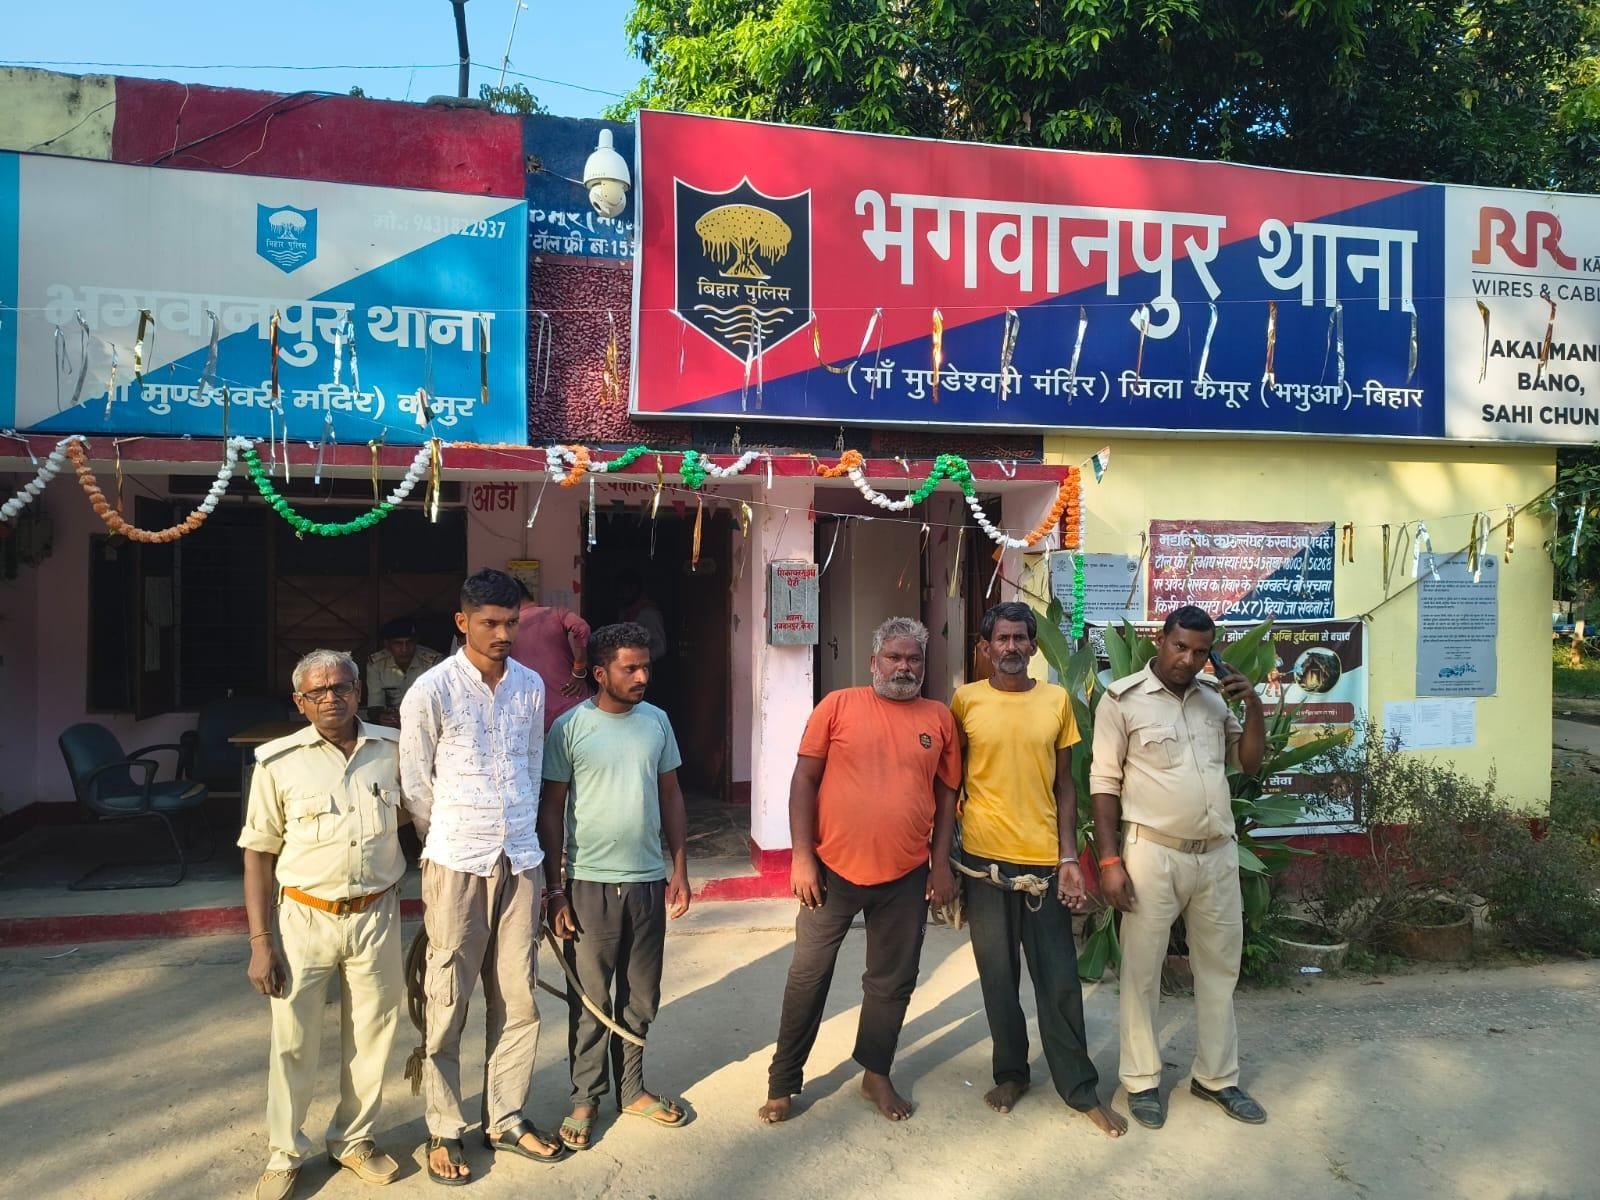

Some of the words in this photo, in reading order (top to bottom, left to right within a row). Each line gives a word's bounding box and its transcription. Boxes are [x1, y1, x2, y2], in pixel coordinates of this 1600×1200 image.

[1472, 206, 1577, 271] RR
[855, 189, 1226, 340] भगवानपुर
[1257, 218, 1418, 312] थाना
[696, 276, 740, 299] बिहार
[744, 281, 792, 305] पुलिस
[1472, 278, 1533, 298] WIRES
[1539, 283, 1551, 298] &
[46, 283, 356, 368] भगवानपुर
[367, 305, 496, 353] थाना
[1117, 370, 1184, 400] जिला
[1191, 373, 1251, 408] कैमूर
[1517, 372, 1585, 396] BANO,
[1481, 404, 1533, 424] SAHI
